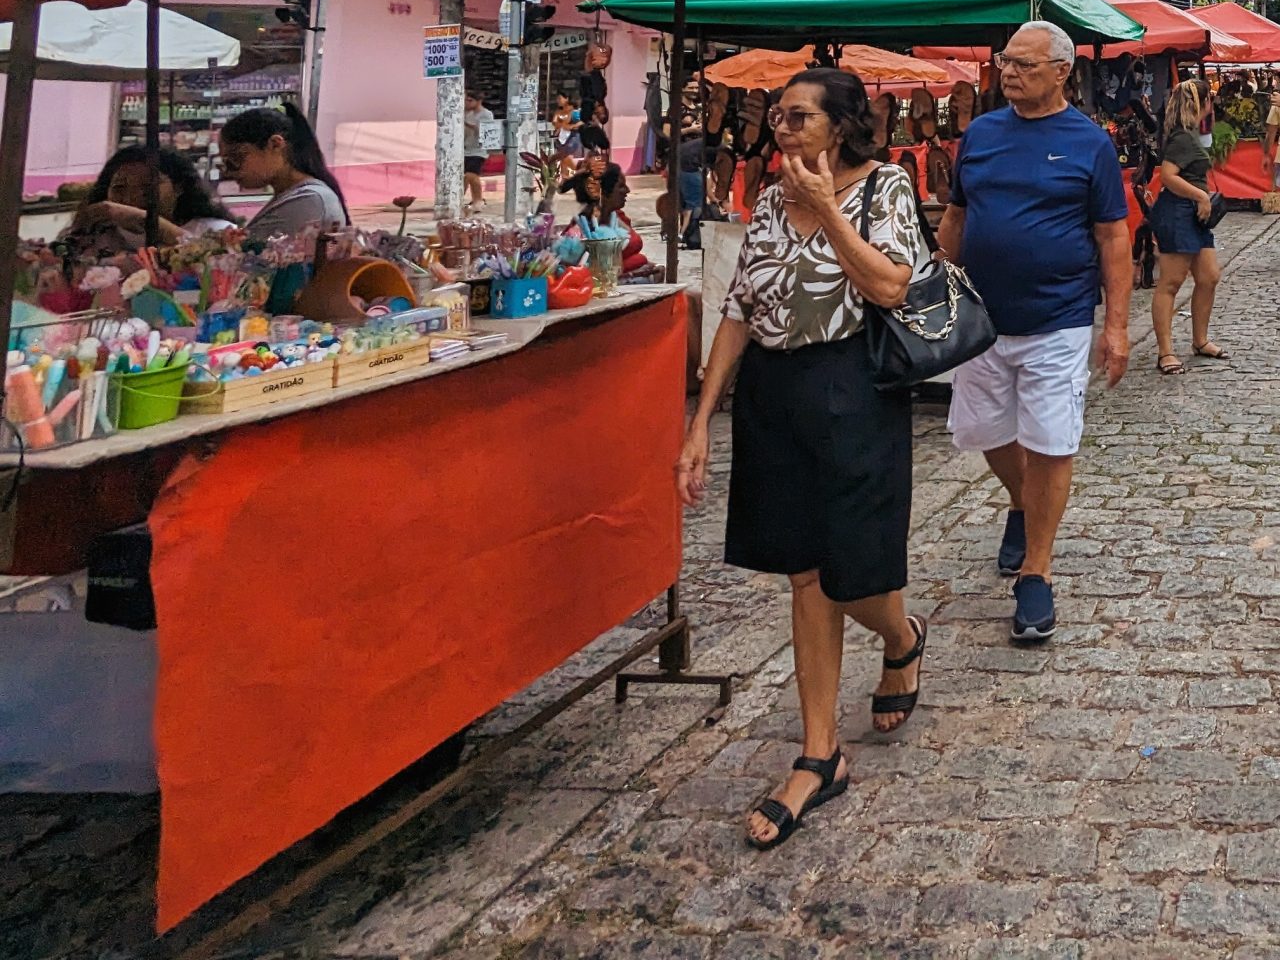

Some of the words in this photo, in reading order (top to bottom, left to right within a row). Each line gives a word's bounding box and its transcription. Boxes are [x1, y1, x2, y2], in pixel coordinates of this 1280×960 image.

[428, 44, 447, 54] 1000
[427, 55, 445, 66] 500
[368, 353, 404, 368] GRATIDÃO
[262, 377, 304, 394] GRATIDÃO
